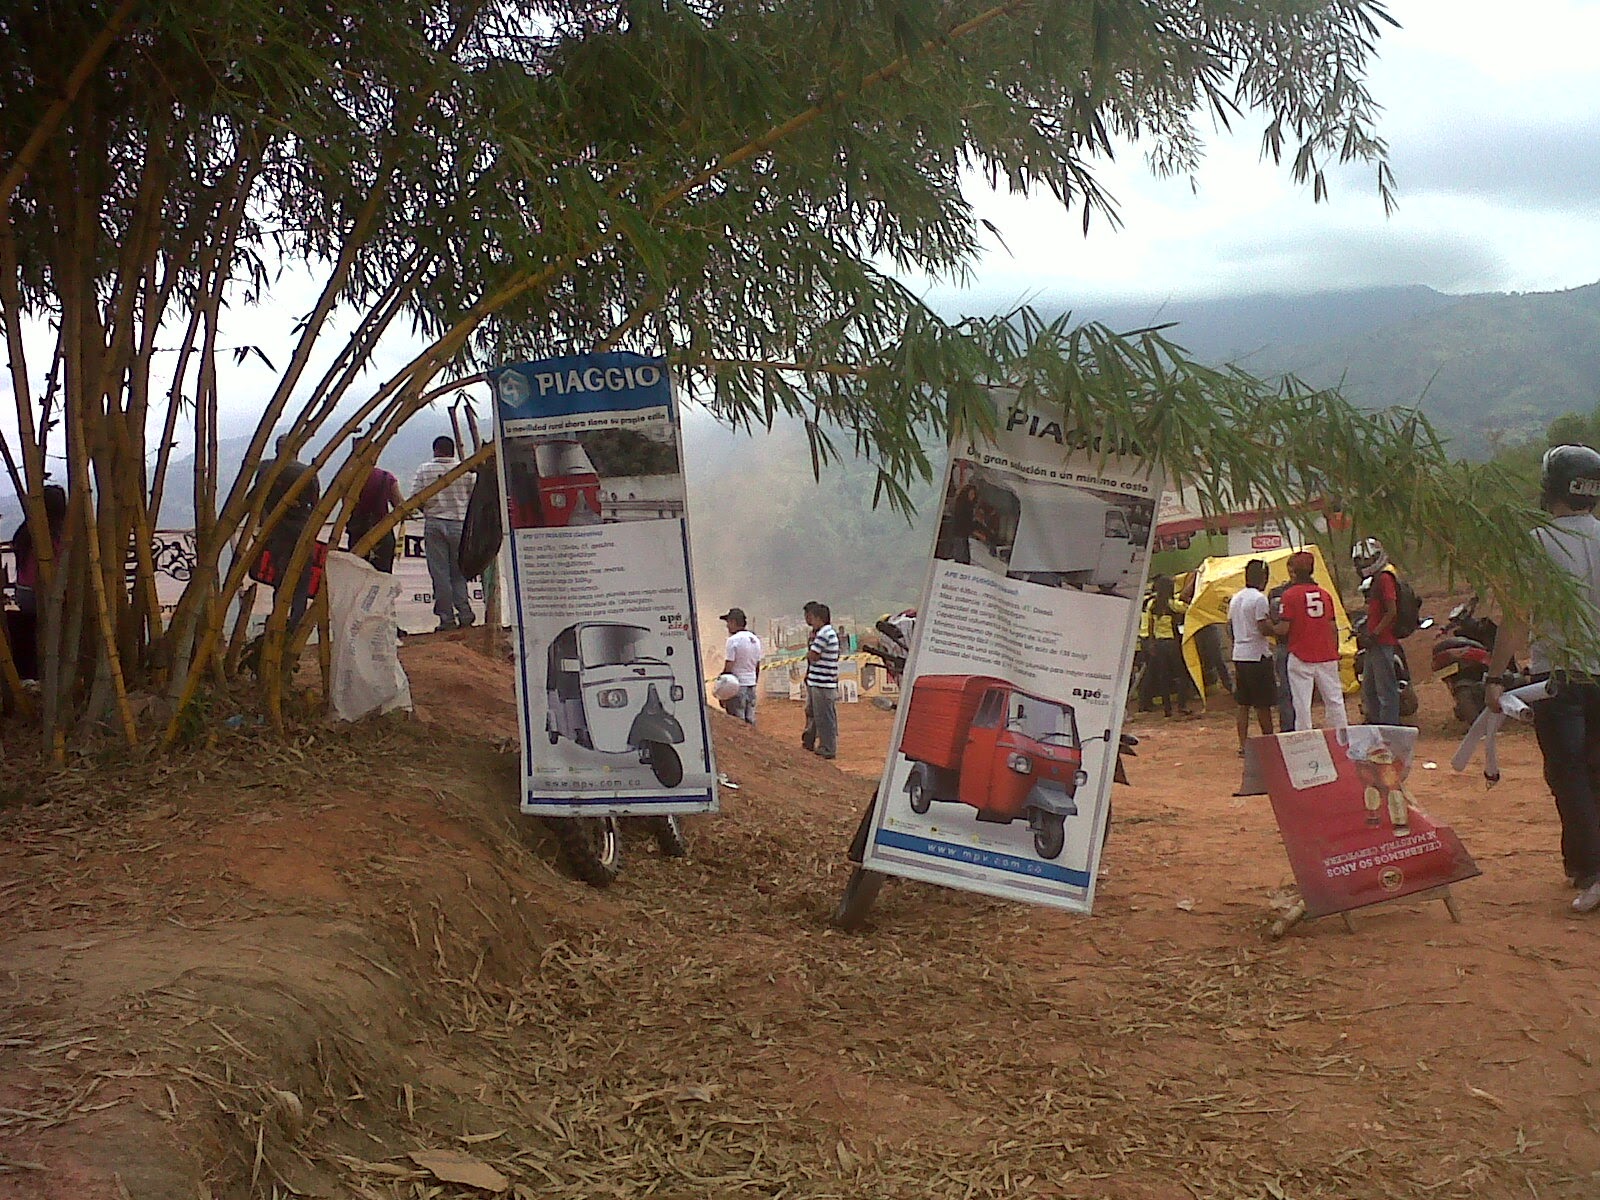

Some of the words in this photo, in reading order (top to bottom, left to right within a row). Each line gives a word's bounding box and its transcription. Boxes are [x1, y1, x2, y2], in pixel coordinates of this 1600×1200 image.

[535, 366, 660, 396] PIAGGIO
[1006, 406, 1152, 457] PIAGI
[983, 452, 1008, 466] gran
[1059, 472, 1073, 480] un
[1120, 480, 1148, 493] costo
[1306, 592, 1324, 618] 5
[1358, 858, 1373, 870] 50
[1374, 840, 1442, 865] CELEBREMOS
[1326, 862, 1357, 878] AÑOS
